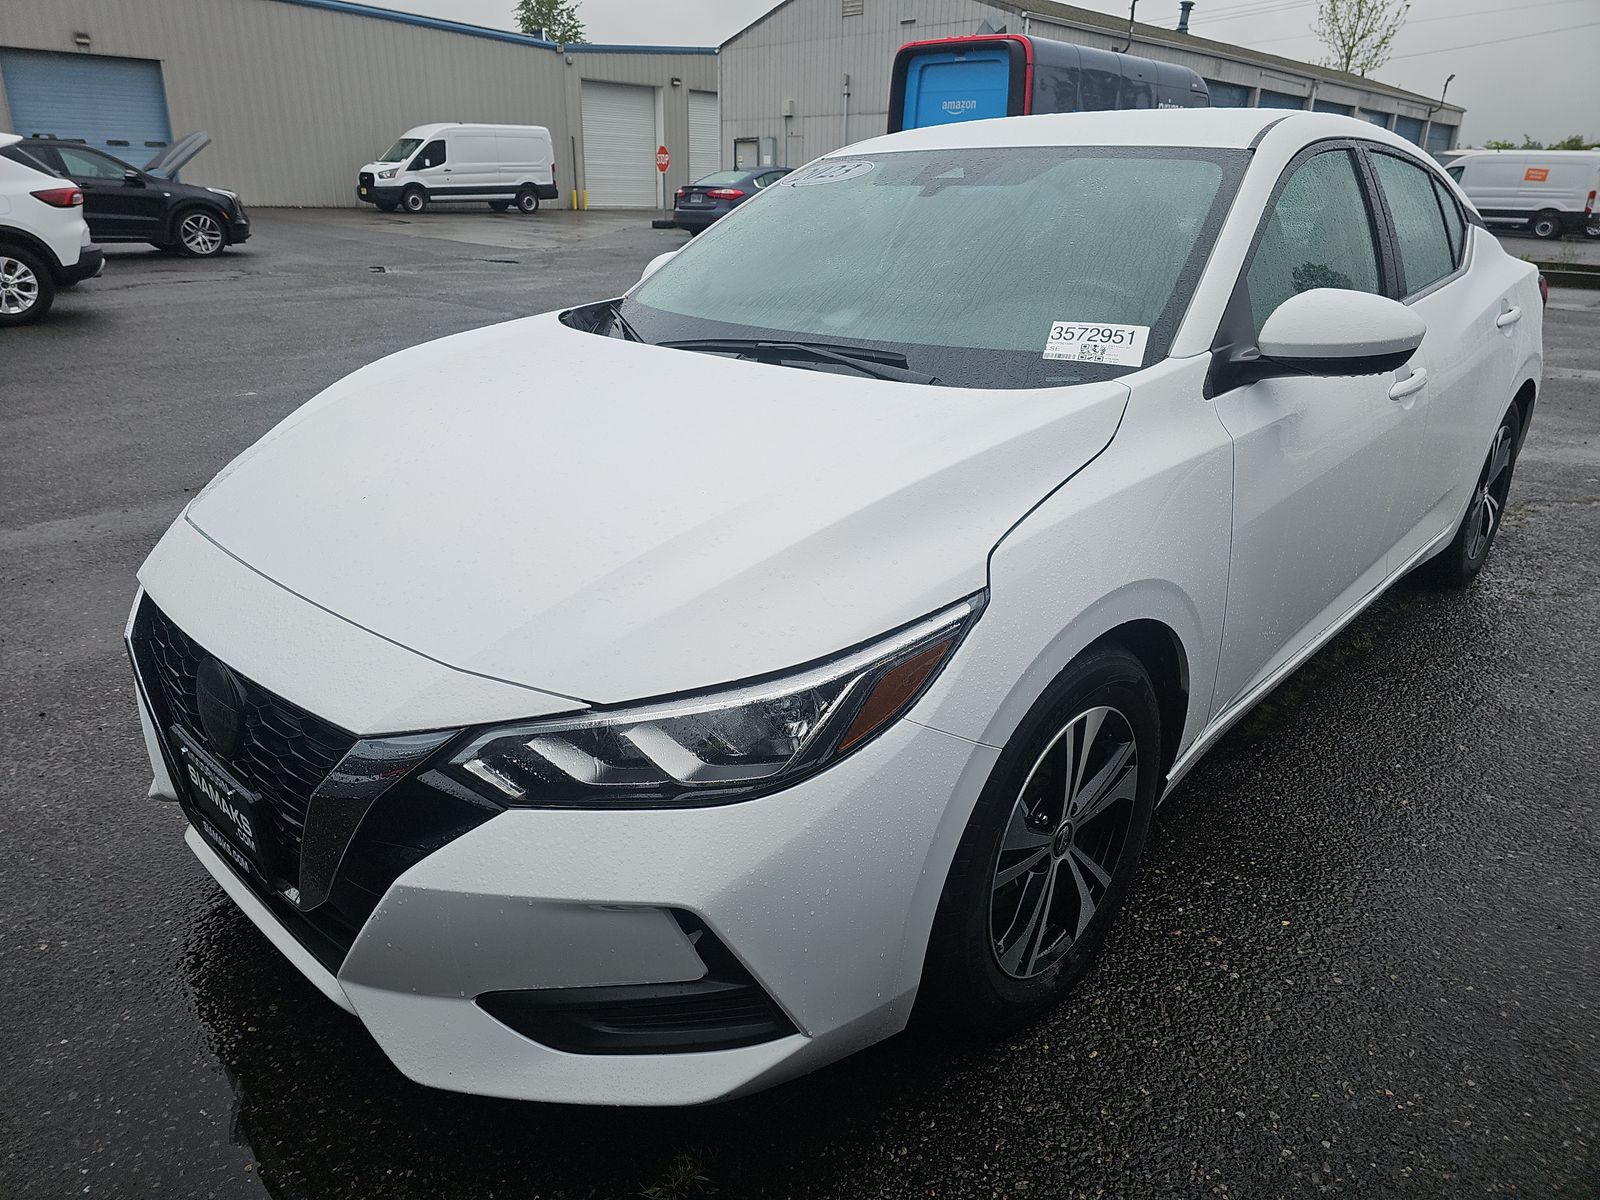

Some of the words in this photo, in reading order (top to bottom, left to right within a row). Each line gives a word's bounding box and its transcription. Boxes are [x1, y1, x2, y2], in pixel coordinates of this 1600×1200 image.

[942, 100, 976, 110] amazon
[656, 154, 669, 164] STOP
[1051, 326, 1135, 345] 3572951
[187, 763, 253, 838] SIAMAKS
